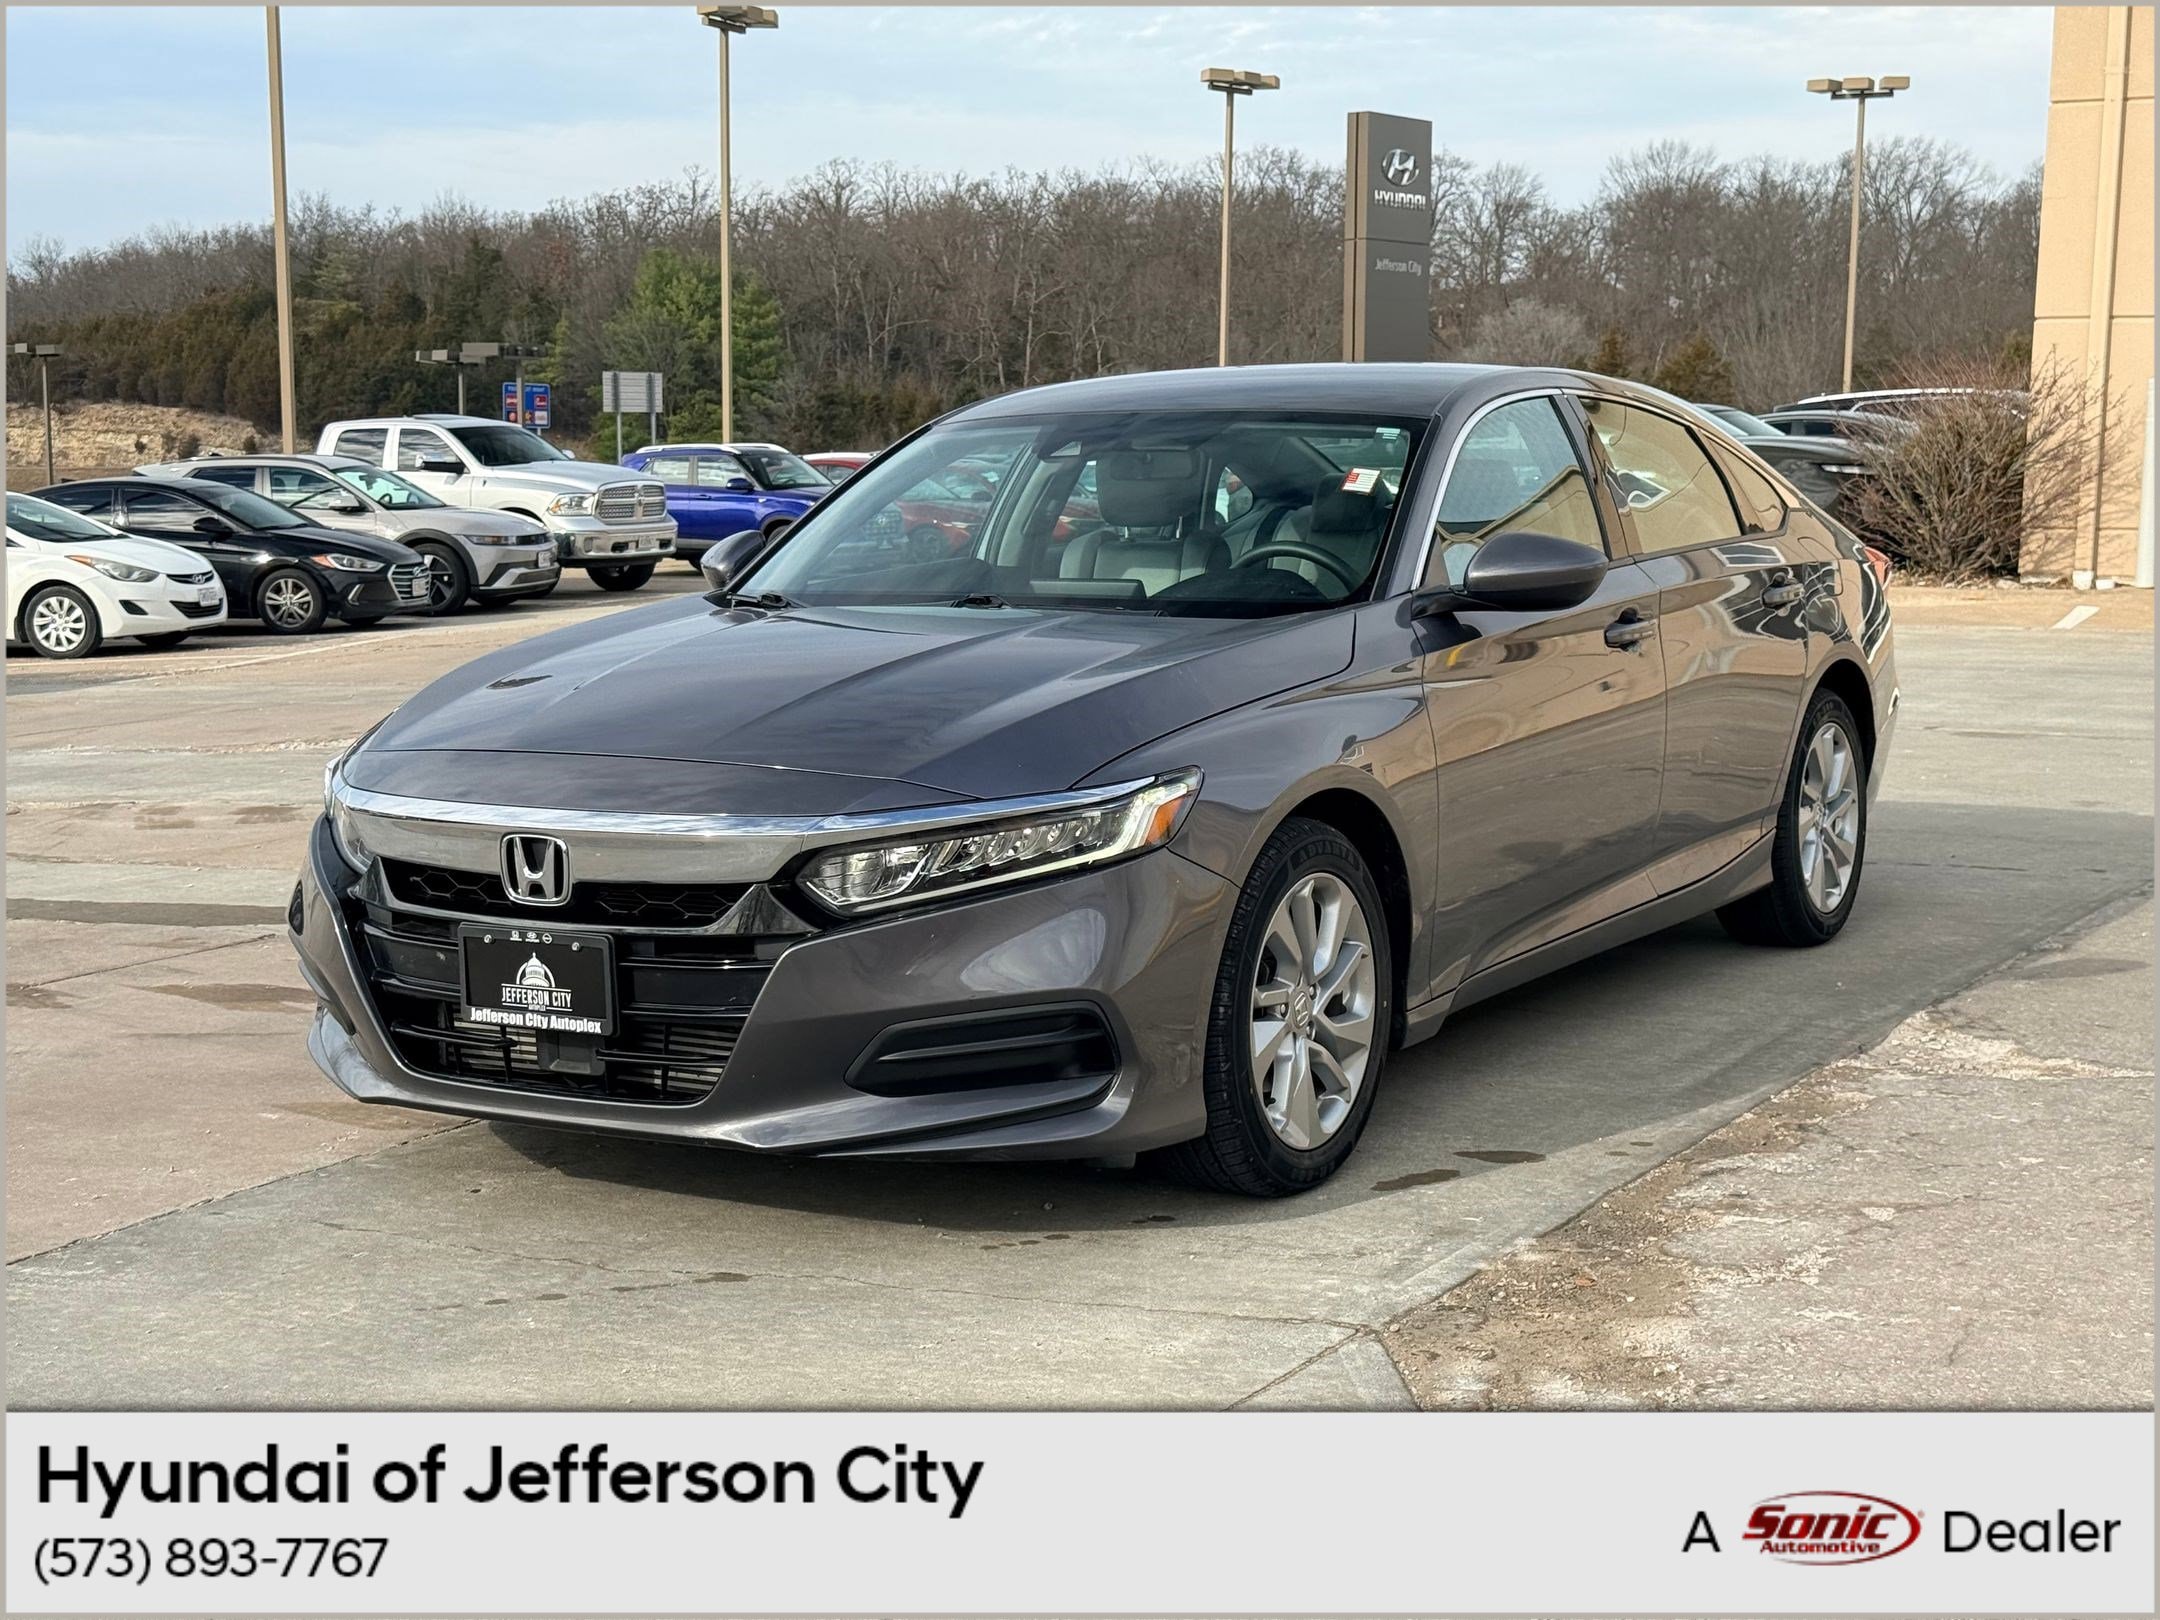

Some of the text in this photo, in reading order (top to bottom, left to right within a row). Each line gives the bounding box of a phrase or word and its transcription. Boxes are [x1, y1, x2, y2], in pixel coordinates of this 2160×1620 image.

[1374, 189, 1427, 210] HYUNDAI
[1375, 258, 1422, 277] Jefferson City
[501, 987, 572, 1008] JEFFERSON CITY
[470, 1007, 602, 1034] Jefferson City Autoplex
